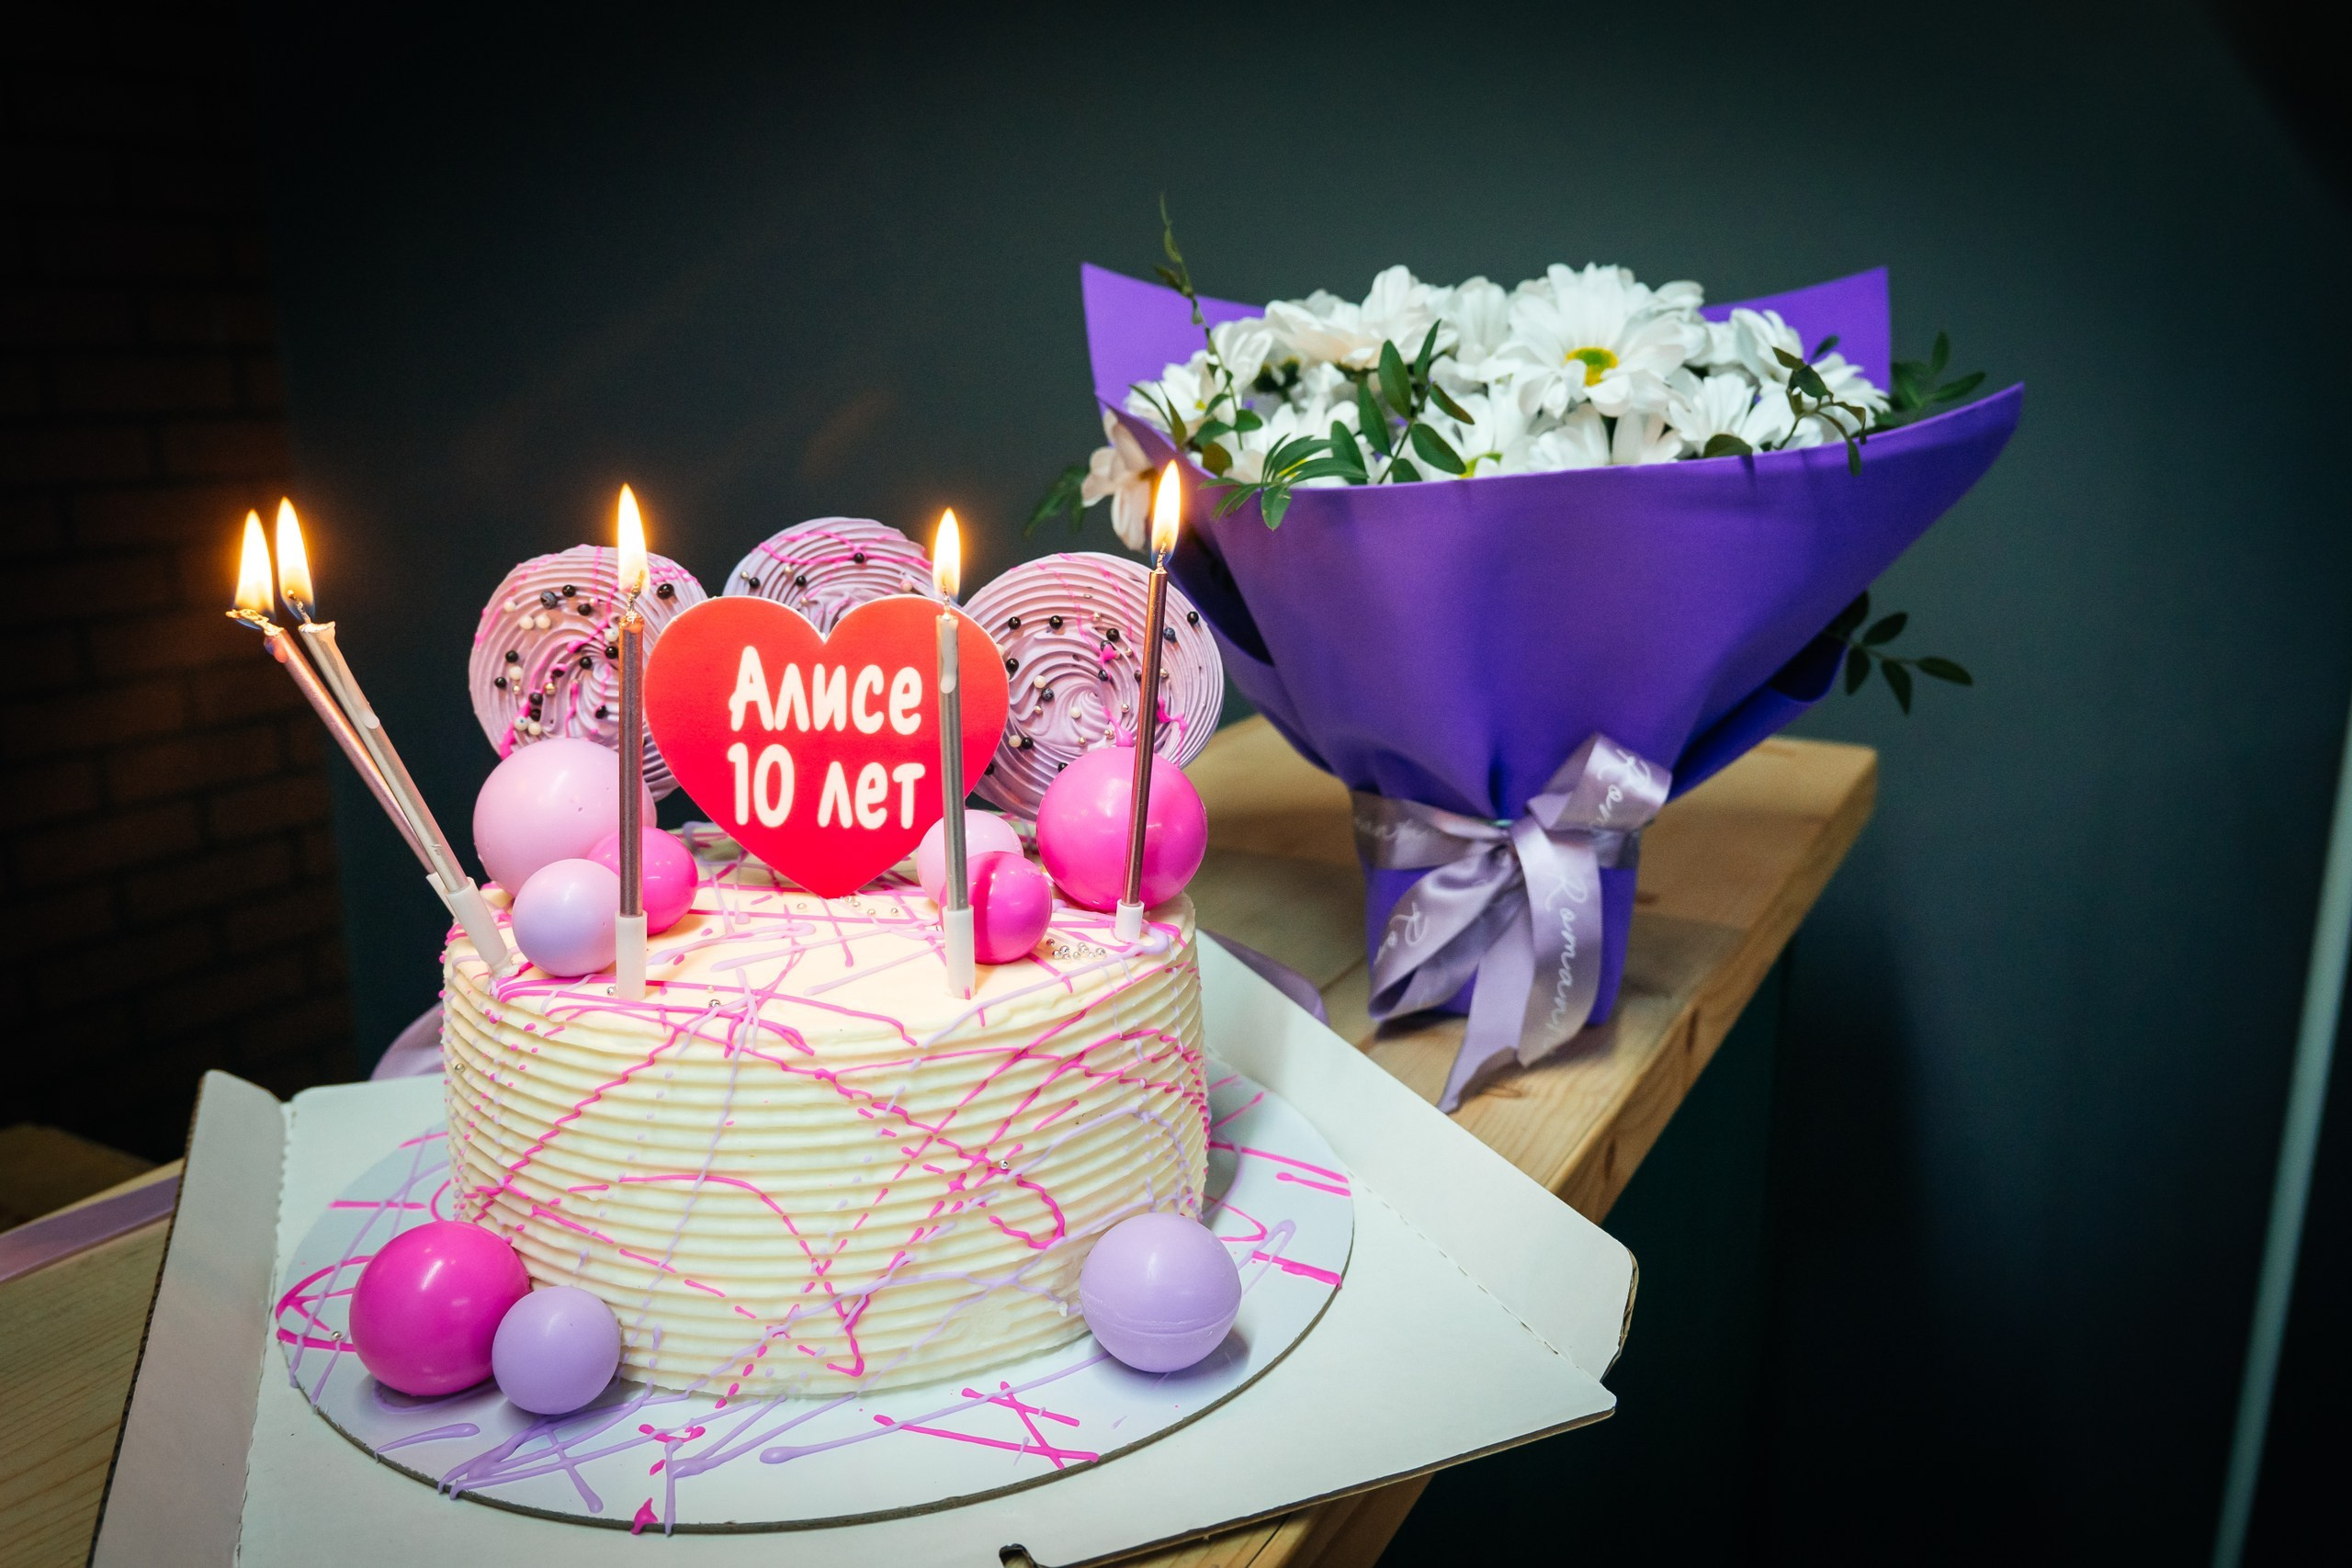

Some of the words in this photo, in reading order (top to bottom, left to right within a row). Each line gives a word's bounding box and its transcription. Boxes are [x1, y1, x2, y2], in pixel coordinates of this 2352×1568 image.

[729, 645, 922, 735] Алисе
[727, 741, 795, 828] 10
[817, 761, 925, 829] лет
